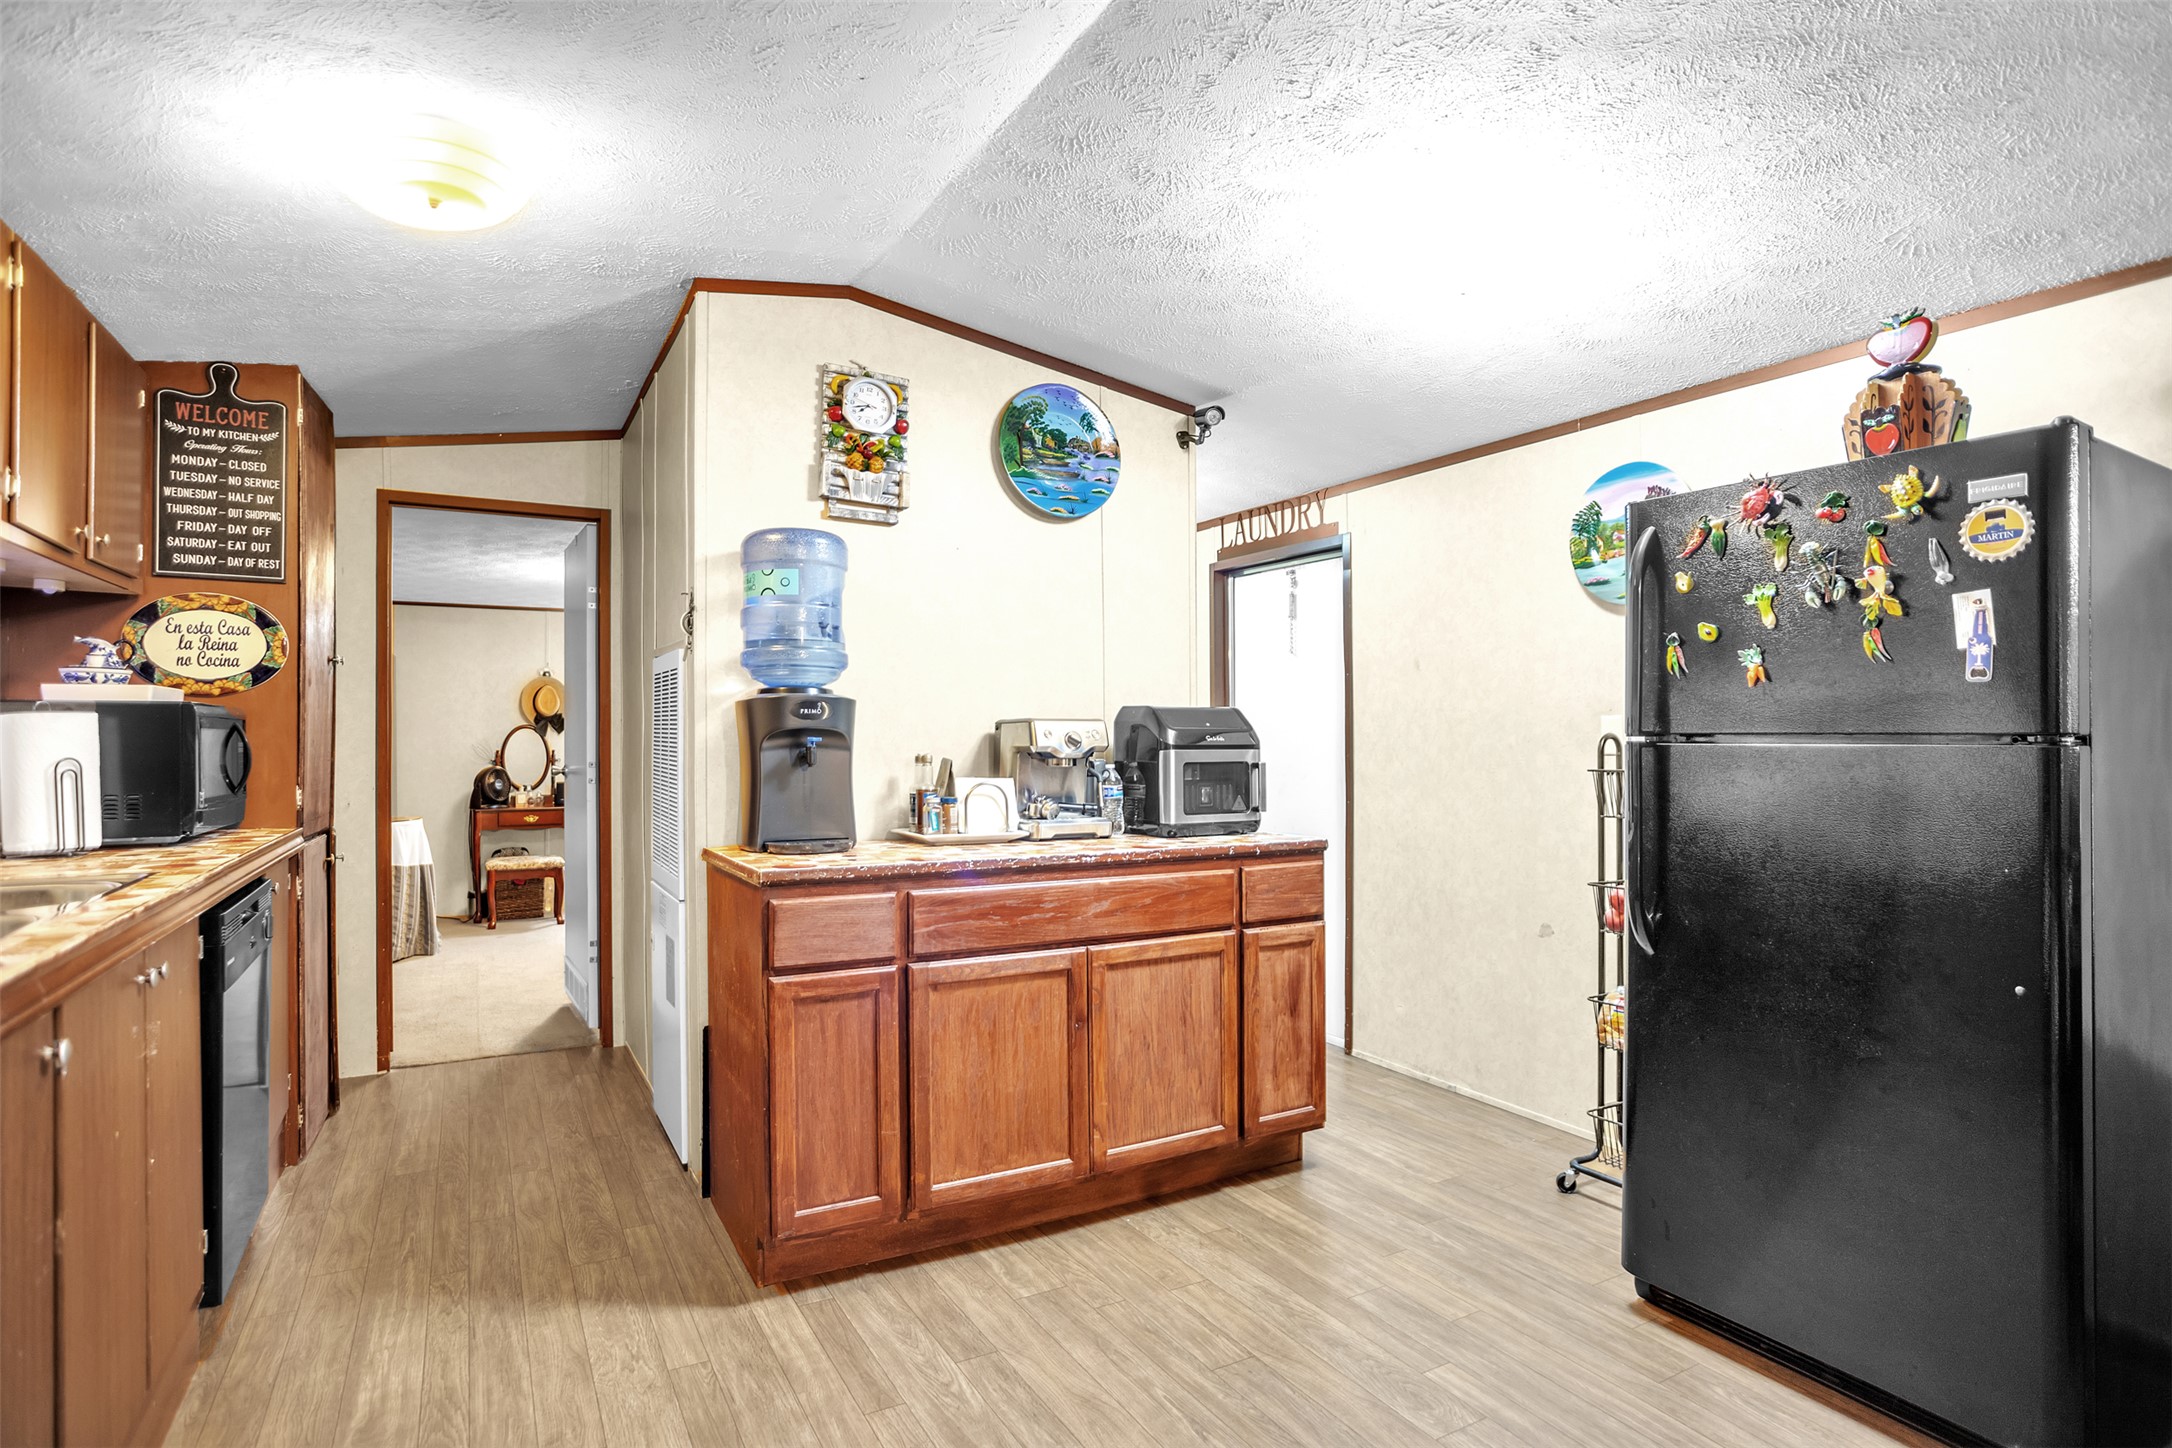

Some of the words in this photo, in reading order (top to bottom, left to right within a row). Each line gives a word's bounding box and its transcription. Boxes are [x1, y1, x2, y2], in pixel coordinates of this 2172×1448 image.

[175, 402, 269, 430] WELCOME
[187, 426, 200, 436] TO
[202, 428, 216, 438] MY
[218, 430, 259, 442] KITCHEN
[184, 439, 227, 453] Operating
[171, 454, 218, 467] MONDAY
[228, 459, 267, 472] CLOSED
[169, 470, 218, 483] TUESDAY
[228, 475, 242, 486] NO
[244, 477, 281, 490] SERVICE
[1969, 481, 2023, 495] FRIGIDAIRE
[163, 486, 218, 499] WEDNESDAY
[228, 492, 254, 503] HALF
[256, 494, 275, 505] DAY
[166, 503, 218, 516] THURSDAY
[228, 508, 243, 518] OUT
[244, 509, 282, 522] SHOPPING
[1219, 487, 1329, 549] LAUNDRY
[177, 520, 217, 533] FRIDAY
[228, 524, 247, 535] DAY
[252, 526, 272, 537] OFF
[1977, 530, 2014, 542] MARTIN
[166, 536, 217, 549] SATURDAY
[227, 540, 247, 551] EAT
[250, 542, 271, 553] OUT
[173, 553, 217, 565] SUNDAY
[227, 557, 244, 567] DAY
[245, 558, 257, 568] OF
[258, 559, 280, 570] REST
[165, 617, 183, 634] En
[186, 620, 214, 635] esta
[217, 619, 252, 636] Casa
[175, 634, 193, 651] la
[197, 634, 239, 651] Reina
[176, 655, 193, 667] no
[196, 651, 241, 668] Cocina
